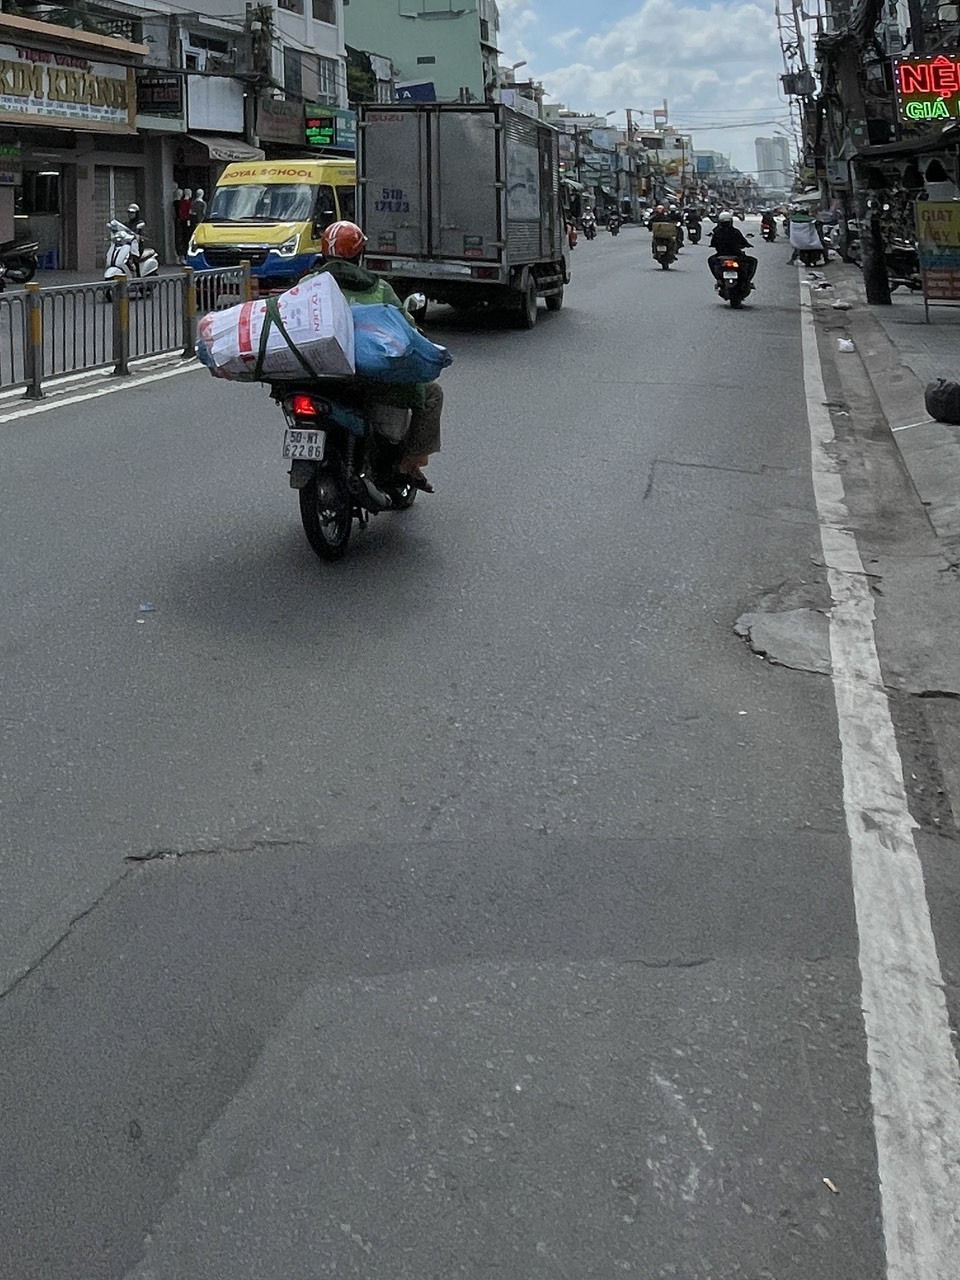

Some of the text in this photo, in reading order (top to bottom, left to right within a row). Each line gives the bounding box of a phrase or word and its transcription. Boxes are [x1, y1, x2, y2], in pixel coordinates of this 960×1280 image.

[906, 97, 950, 119] GIÁ
[367, 114, 404, 122] ISUZU
[223, 168, 314, 179] ROYAL SCHOOL
